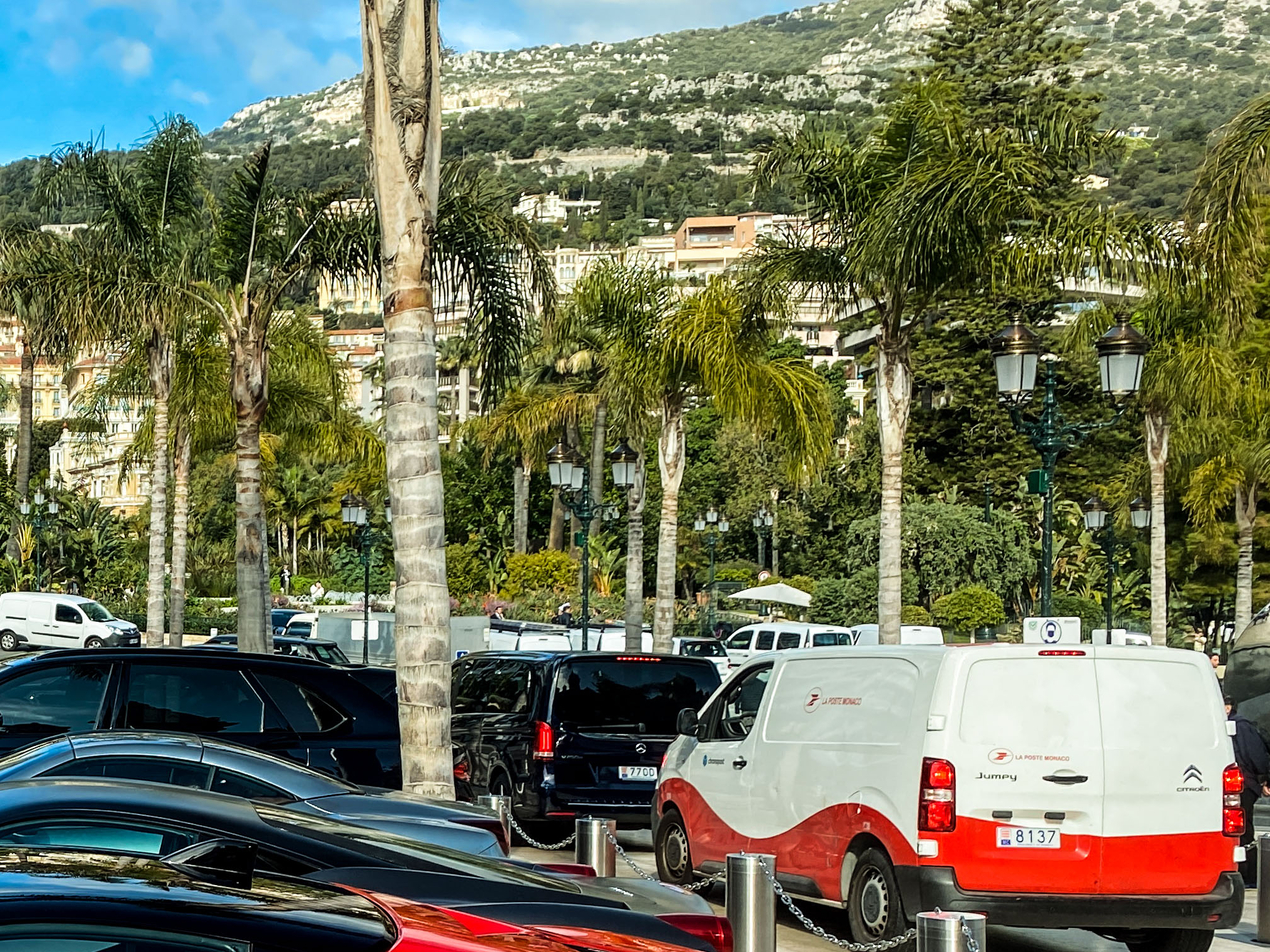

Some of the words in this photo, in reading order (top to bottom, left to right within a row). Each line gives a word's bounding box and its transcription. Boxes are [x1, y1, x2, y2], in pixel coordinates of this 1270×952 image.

[630, 767, 655, 777] 7700
[975, 772, 1017, 782] Jumpy
[1016, 829, 1056, 843] 8137
